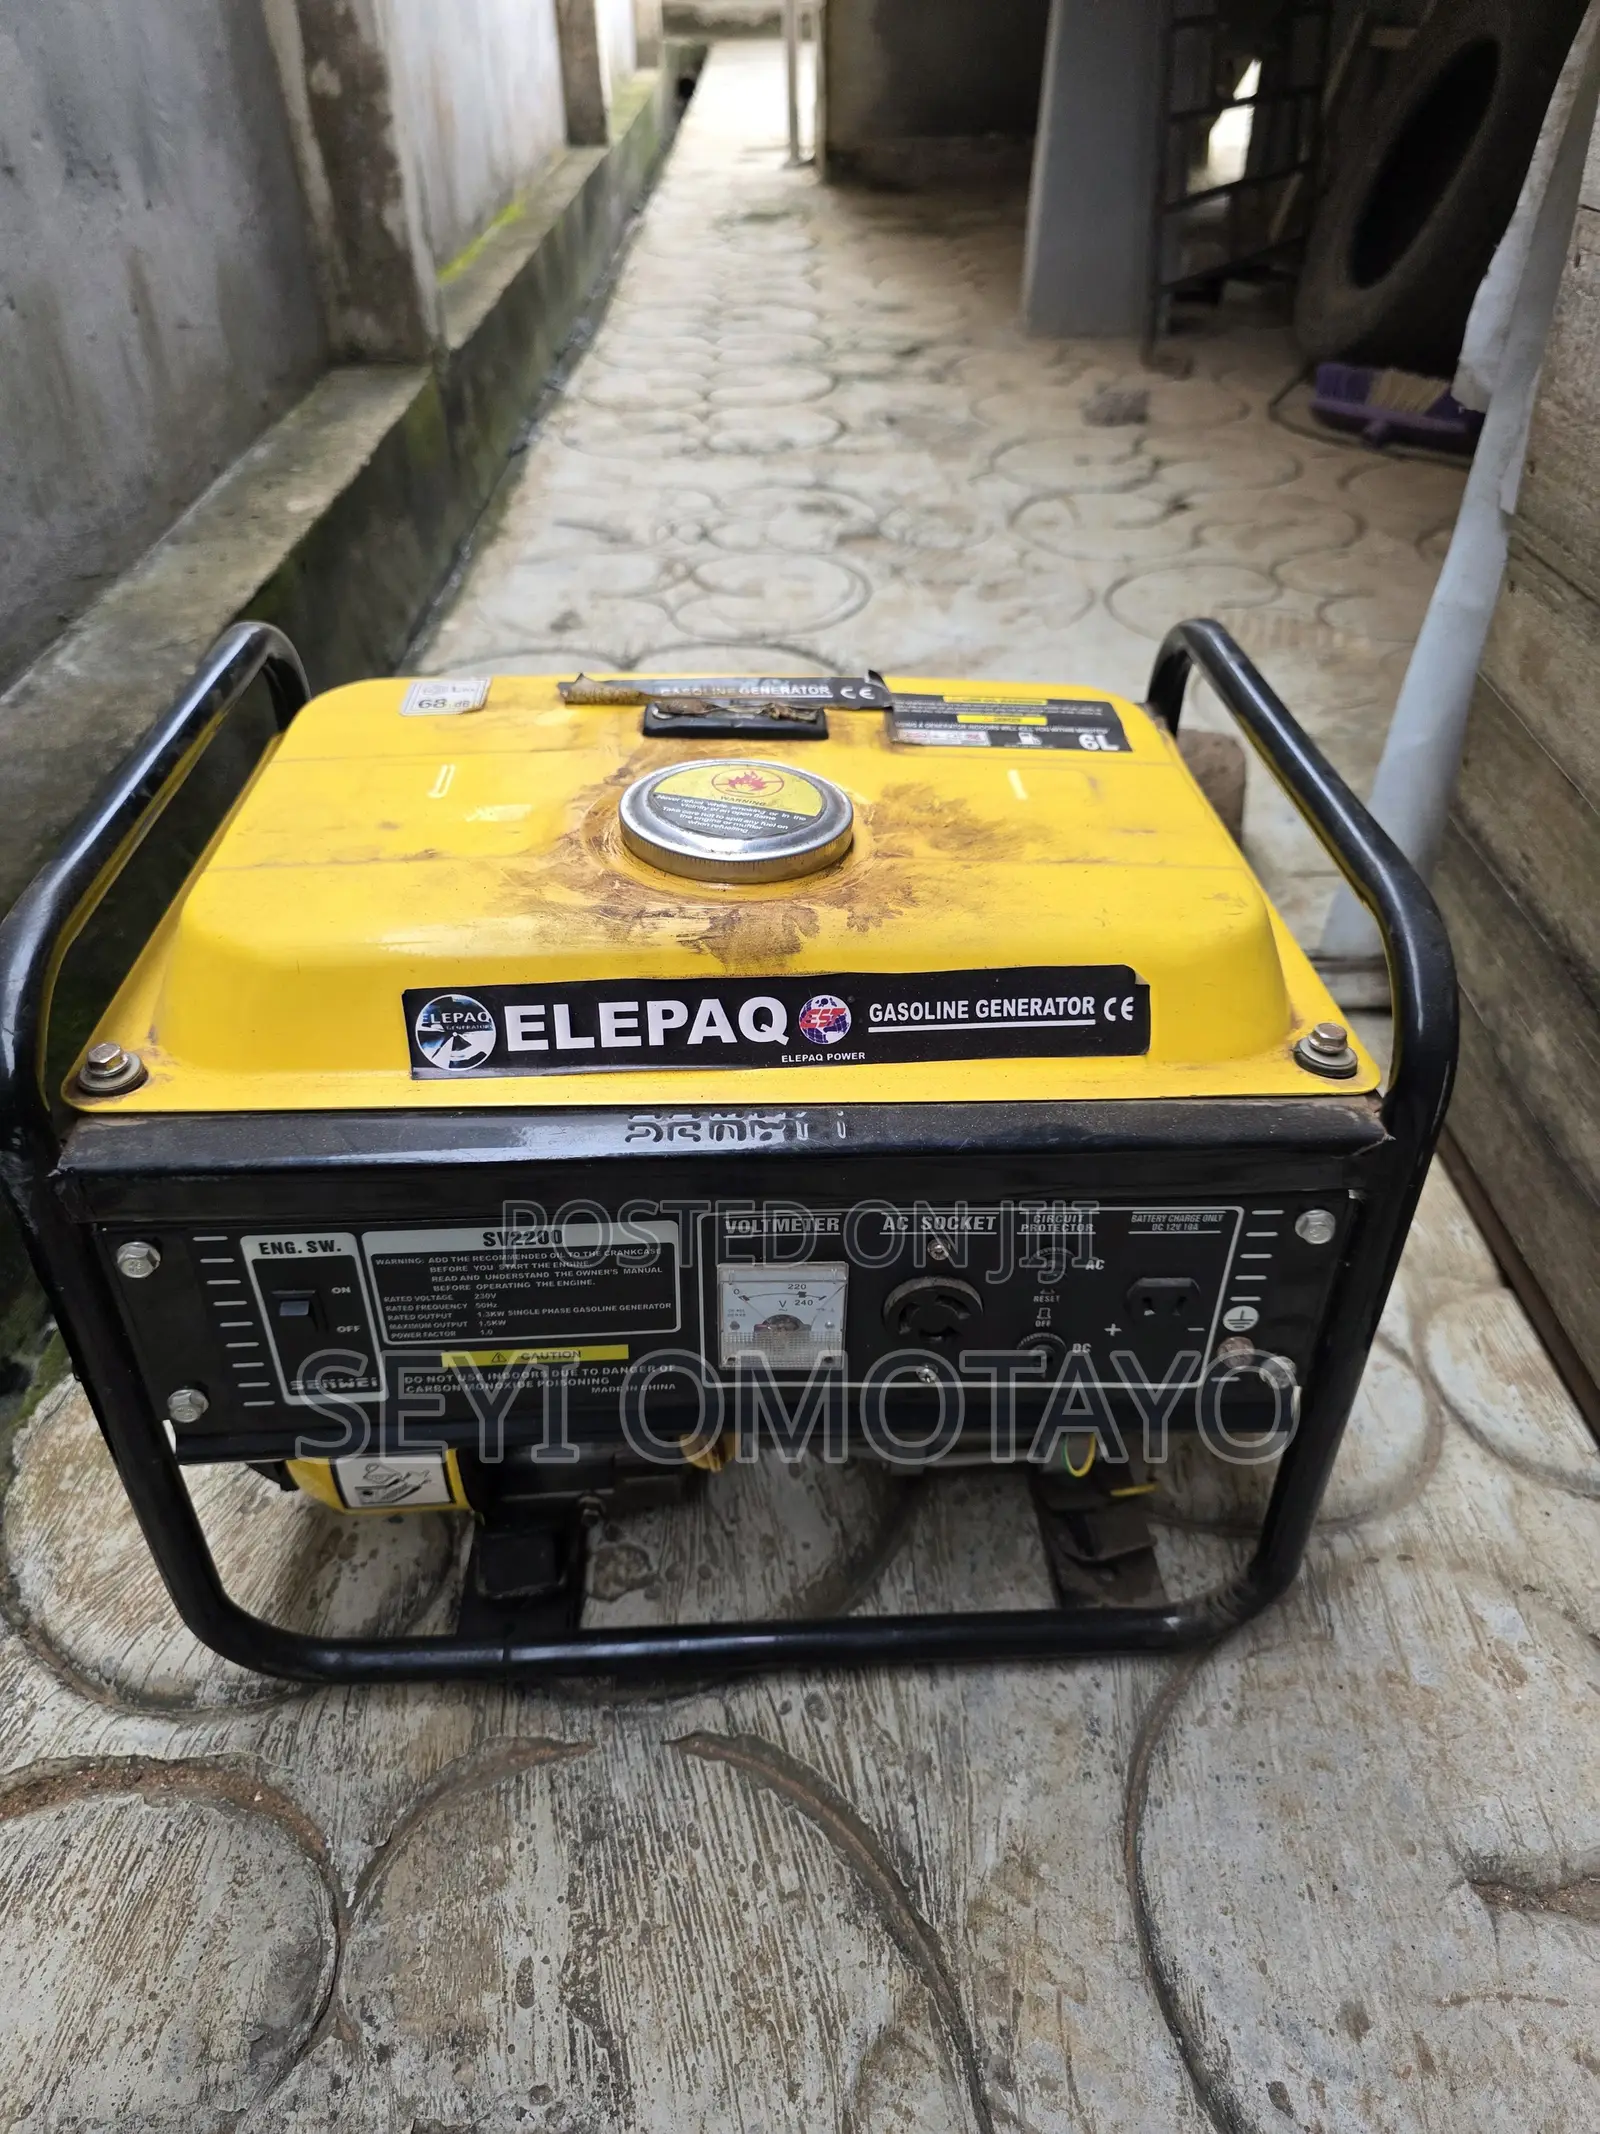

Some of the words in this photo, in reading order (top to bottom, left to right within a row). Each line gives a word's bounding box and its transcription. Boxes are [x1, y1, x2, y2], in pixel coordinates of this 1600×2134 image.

[739, 684, 830, 696] GENERATOR
[419, 698, 447, 709] 68
[1078, 732, 1119, 751] 6L
[682, 797, 704, 806] refuel
[707, 801, 728, 809] while
[731, 805, 766, 816] smoking
[720, 796, 767, 806] WARNING
[732, 809, 751, 817] open
[694, 816, 722, 826] engine
[726, 815, 743, 824] spill
[761, 821, 776, 829] fuel
[869, 999, 970, 1022] GASOLINE
[976, 996, 1096, 1019] GENERATOR
[422, 1012, 491, 1024] ELEPAQ
[800, 1008, 846, 1029] EST
[503, 996, 790, 1052] ELEPAQ
[782, 1053, 824, 1063] ELEPAQ
[826, 1052, 866, 1061] POWER
[883, 1216, 908, 1231] AC
[920, 1215, 997, 1231] SOCKET
[1131, 1214, 1167, 1223] BATTERY
[1168, 1214, 1201, 1223] CHARGE
[1202, 1214, 1224, 1222] ONLY
[725, 1216, 840, 1234] VOLTMETER
[483, 1229, 564, 1247] SV2200
[259, 1241, 303, 1255] ENG.
[306, 1240, 342, 1253] SW.
[375, 1257, 425, 1266] WARNING:
[428, 1256, 449, 1264] ADD
[472, 1252, 547, 1262] RECOMMENDED
[1085, 1259, 1105, 1270] AC
[430, 1265, 469, 1273] BEFORE
[499, 1262, 529, 1270] START
[459, 1274, 480, 1282] AND
[485, 1270, 550, 1280] UNDERSTAND
[576, 1269, 619, 1277] OWNER'S
[623, 1266, 663, 1275] MANUAL
[433, 1284, 472, 1292] BEFORE
[476, 1282, 531, 1290] OPERATING
[557, 1279, 596, 1287] ENGINE.
[384, 1295, 413, 1303] RATED
[414, 1294, 454, 1302] VOLTAGE
[1033, 1295, 1060, 1303] RESET
[385, 1304, 415, 1312] RATED
[416, 1303, 468, 1311] FREQUENCY
[387, 1313, 416, 1321] RATED
[417, 1312, 453, 1320] OUTPUT
[508, 1308, 540, 1316] SINGLE
[542, 1307, 572, 1315] PHASE
[573, 1305, 618, 1314] GASOLINE
[619, 1302, 672, 1311] GENERATOR
[336, 1325, 361, 1333] OFF
[389, 1322, 432, 1330] MAXIMUM
[423, 1330, 456, 1338] FACTOR
[1072, 1343, 1091, 1353] DC
[521, 1350, 582, 1361] CAUTION
[404, 1376, 423, 1384] DO
[426, 1374, 454, 1383] NOT
[581, 1367, 599, 1376] TO
[405, 1383, 461, 1393] CARBON
